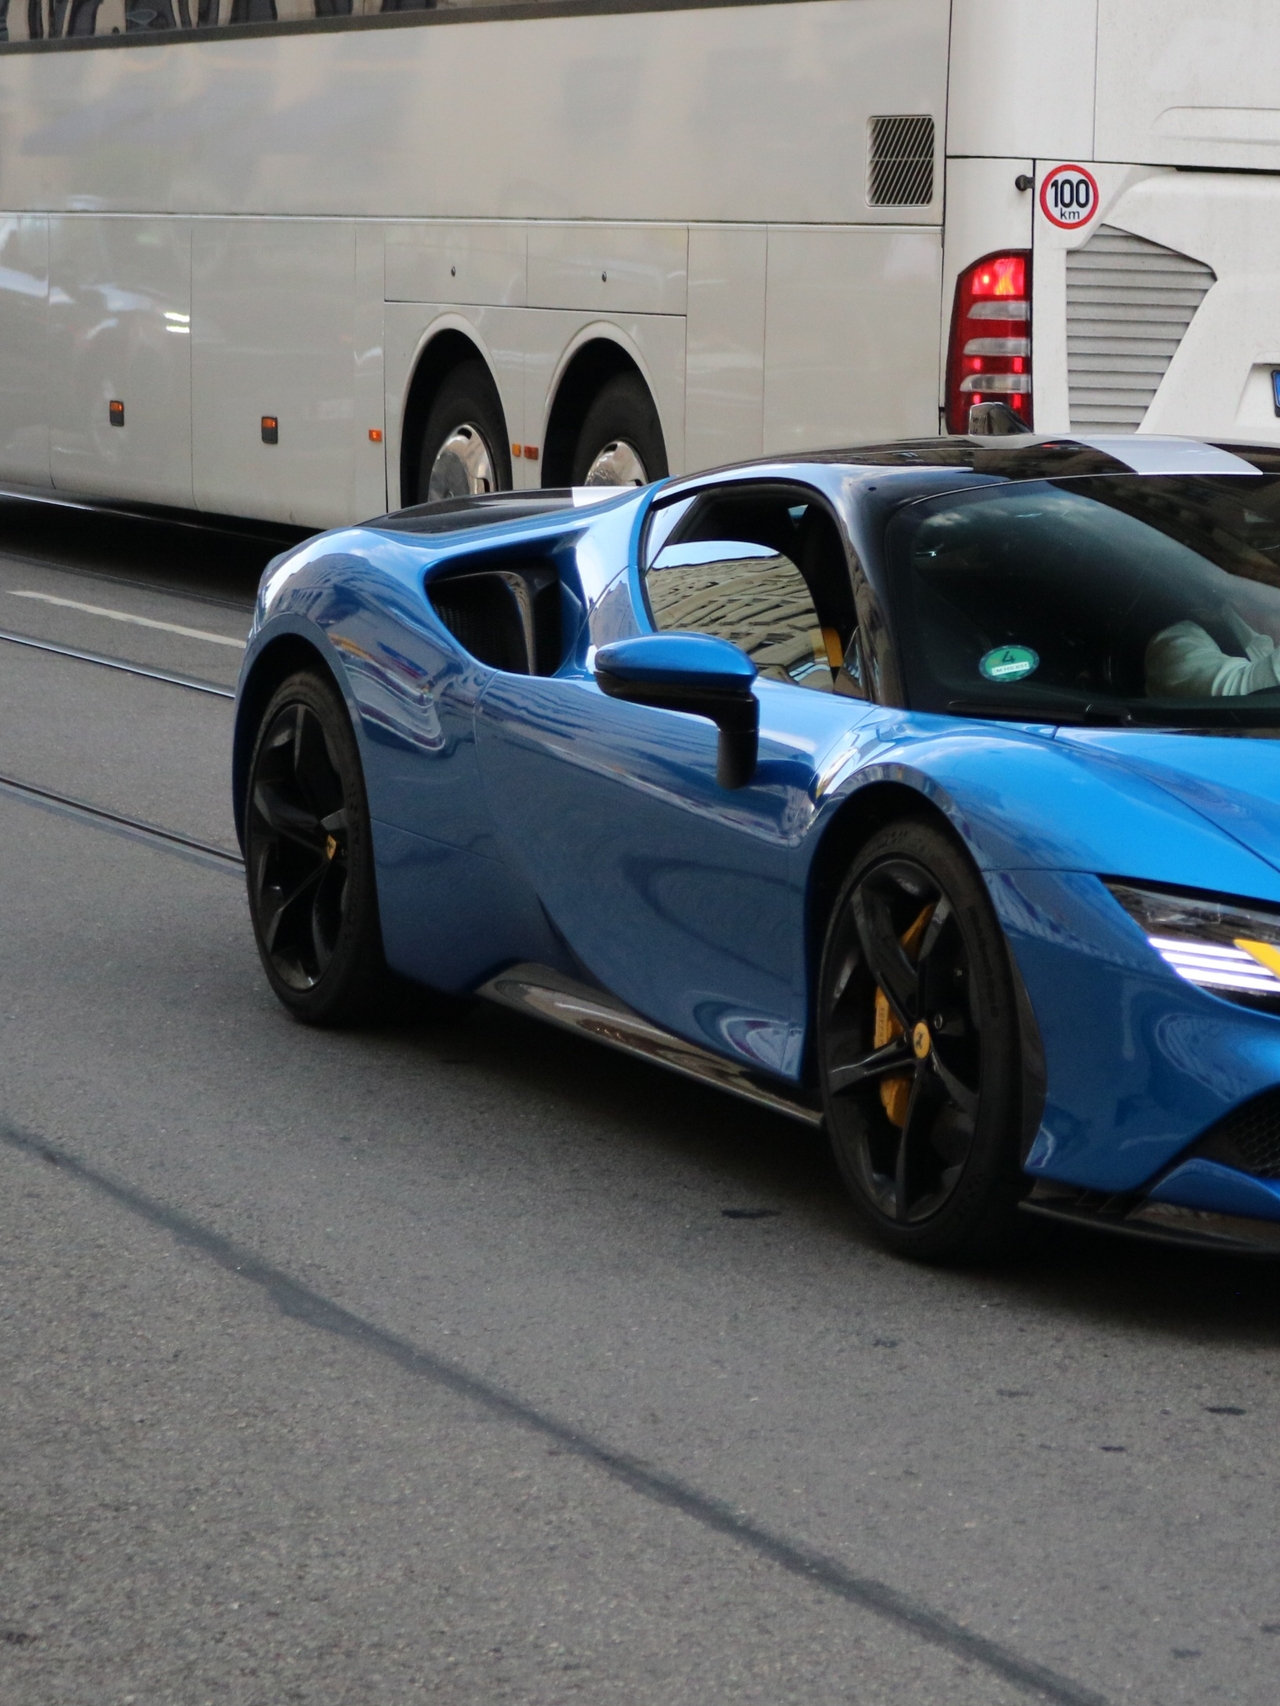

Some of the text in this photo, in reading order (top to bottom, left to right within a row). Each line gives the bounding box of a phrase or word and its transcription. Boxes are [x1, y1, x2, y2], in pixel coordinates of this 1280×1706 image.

[1050, 178, 1090, 209] 100
[1060, 208, 1080, 220] km
[1002, 650, 1016, 663] 4
